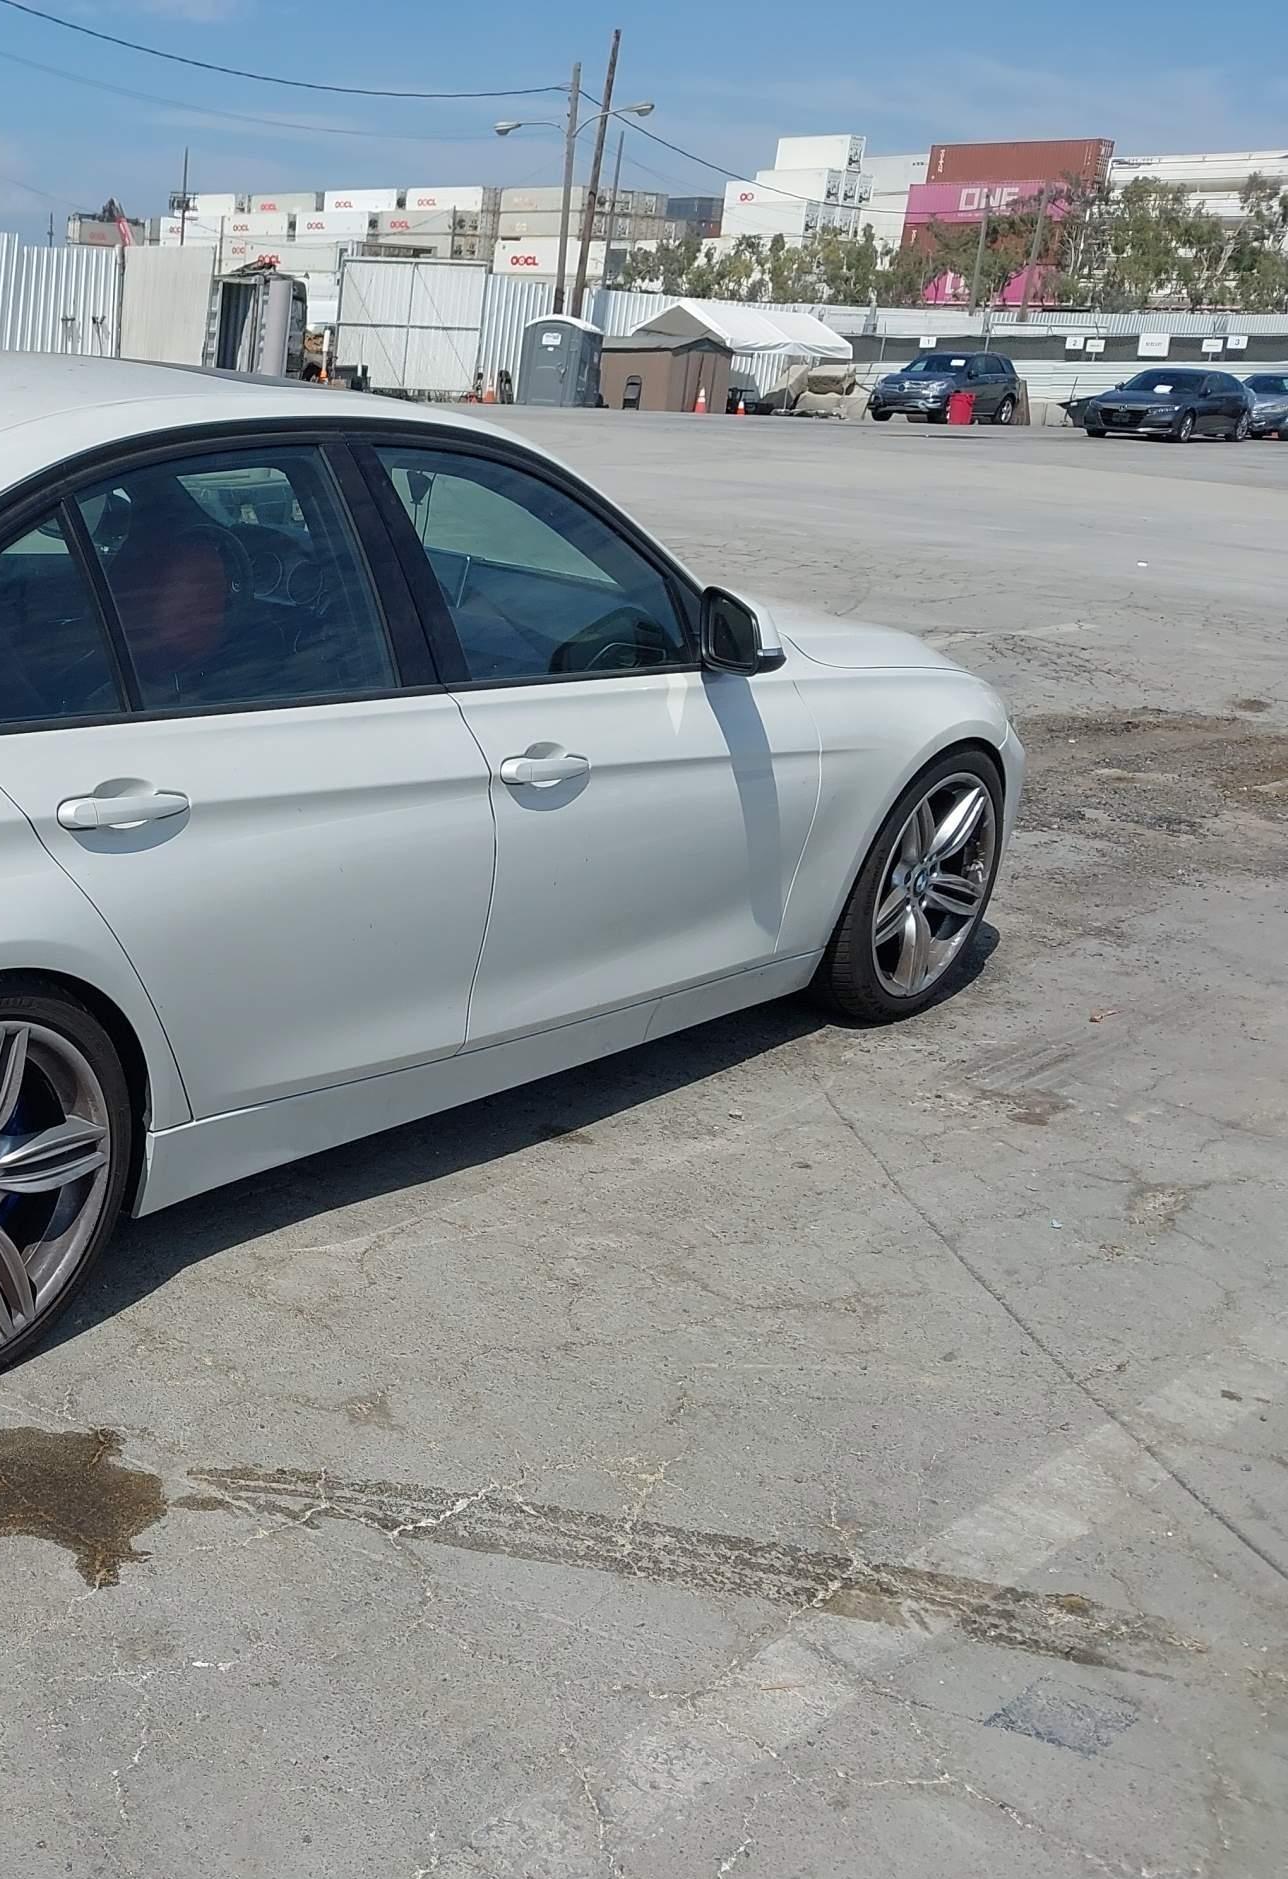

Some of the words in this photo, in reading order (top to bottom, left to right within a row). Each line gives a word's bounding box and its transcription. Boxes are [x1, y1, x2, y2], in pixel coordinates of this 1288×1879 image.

[417, 198, 437, 207] OOCL
[959, 187, 1019, 210] ONE
[334, 201, 353, 209] OOCL
[232, 224, 249, 232] OOCL
[306, 222, 325, 230] OOCL
[390, 220, 410, 229] OOCL
[510, 255, 539, 266] OOCL
